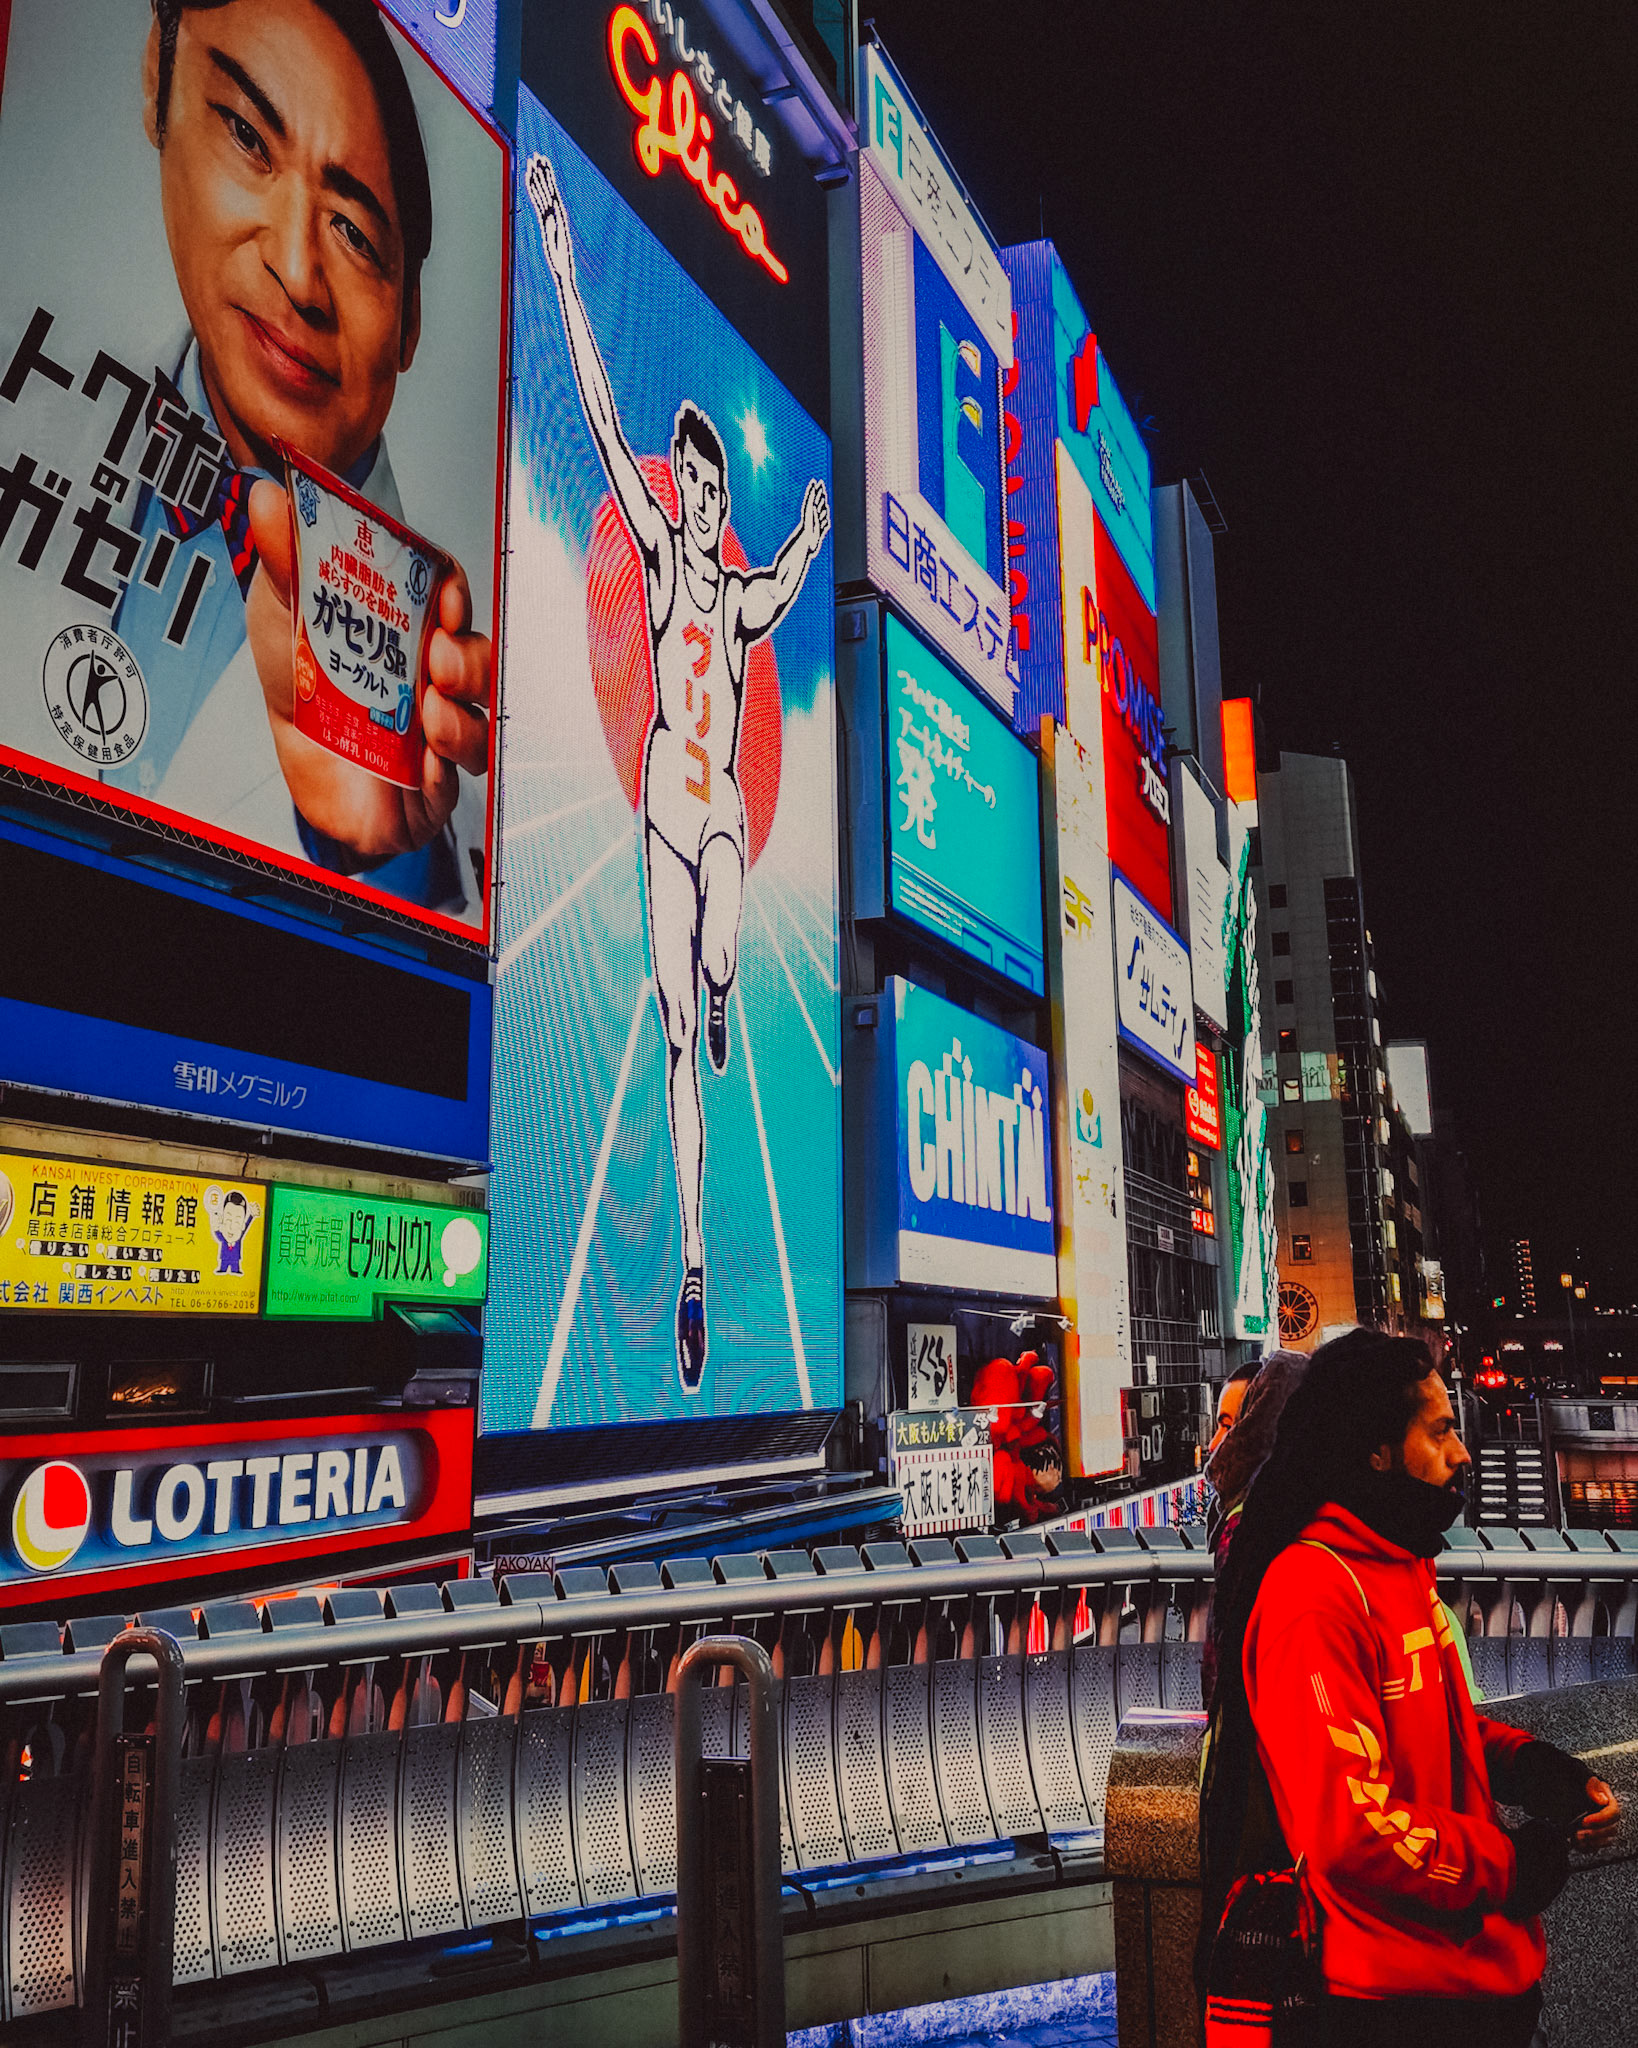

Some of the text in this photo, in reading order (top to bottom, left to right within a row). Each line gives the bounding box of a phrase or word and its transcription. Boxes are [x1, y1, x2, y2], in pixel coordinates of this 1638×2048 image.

[606, 3, 790, 284] Glico
[0, 306, 227, 517] トクホ
[0, 453, 216, 650] ガセリ
[354, 519, 378, 558] 恵
[59, 628, 137, 679] 消費者庁許可
[329, 648, 389, 699] ヨーグルト
[1080, 586, 1168, 777] PROMISE
[51, 704, 136, 761] 特定保健用食品
[322, 727, 389, 772] はっ酵乳 100g
[173, 1060, 307, 1110] 雪印メグミルク
[29, 1180, 198, 1229] 店舗情報館
[32, 1164, 200, 1194] KANSAI INVEST CORPORATION
[278, 1209, 432, 1281] 賃貸・売買 ピタットハウス
[59, 1282, 164, 1306] 関西インベスト
[171, 1298, 255, 1309] TEL 06-6766-2016
[111, 1445, 405, 1547] LOTTERIA
[903, 1461, 980, 1522] 大阪に乾杯
[496, 1556, 554, 1572] TAKOYAKI
[118, 1753, 142, 1949] 自転車進入禁止
